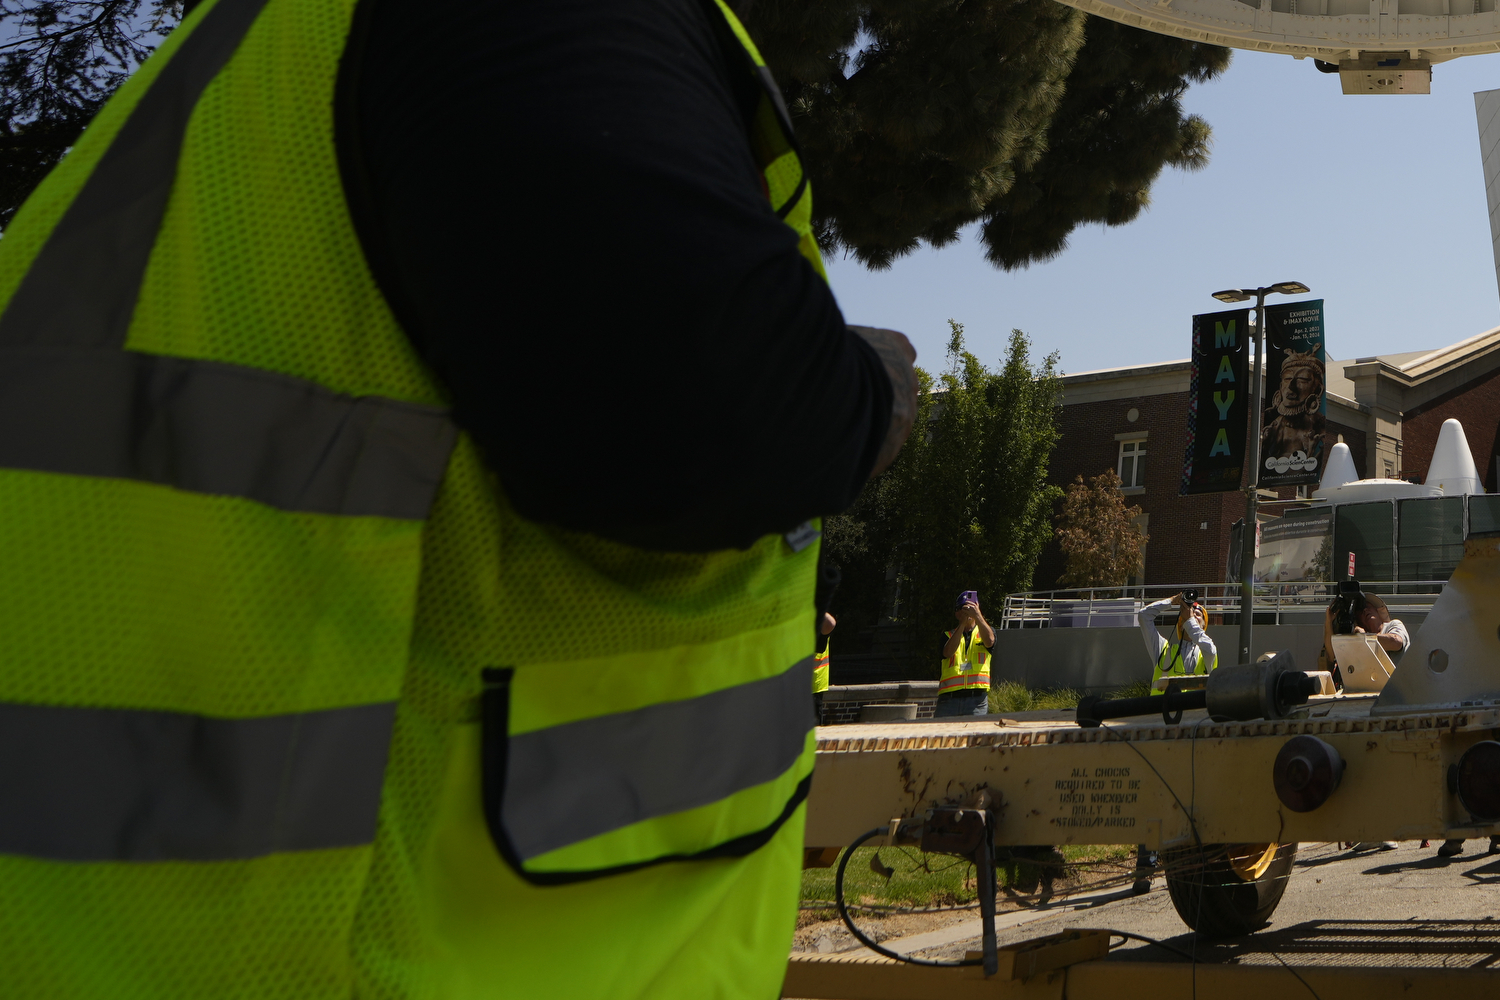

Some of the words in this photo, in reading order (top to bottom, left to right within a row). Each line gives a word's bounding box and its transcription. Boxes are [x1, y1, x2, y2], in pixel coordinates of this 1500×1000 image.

[1289, 309, 1320, 318] EXHIBITION
[1288, 317, 1302, 325] IMAX
[1303, 315, 1320, 323] MOVIE
[1209, 319, 1236, 457] MAYA
[1071, 767, 1088, 778] ALL
[1095, 767, 1131, 778] CHOCKS
[1055, 780, 1106, 790] REQUIRED
[1110, 780, 1122, 790] TO
[1128, 780, 1141, 790] BE
[1060, 793, 1085, 803] USED
[1071, 805, 1102, 815] DOLLY
[1110, 805, 1121, 815] IS
[1055, 816, 1136, 827] STOWED/PARKED
